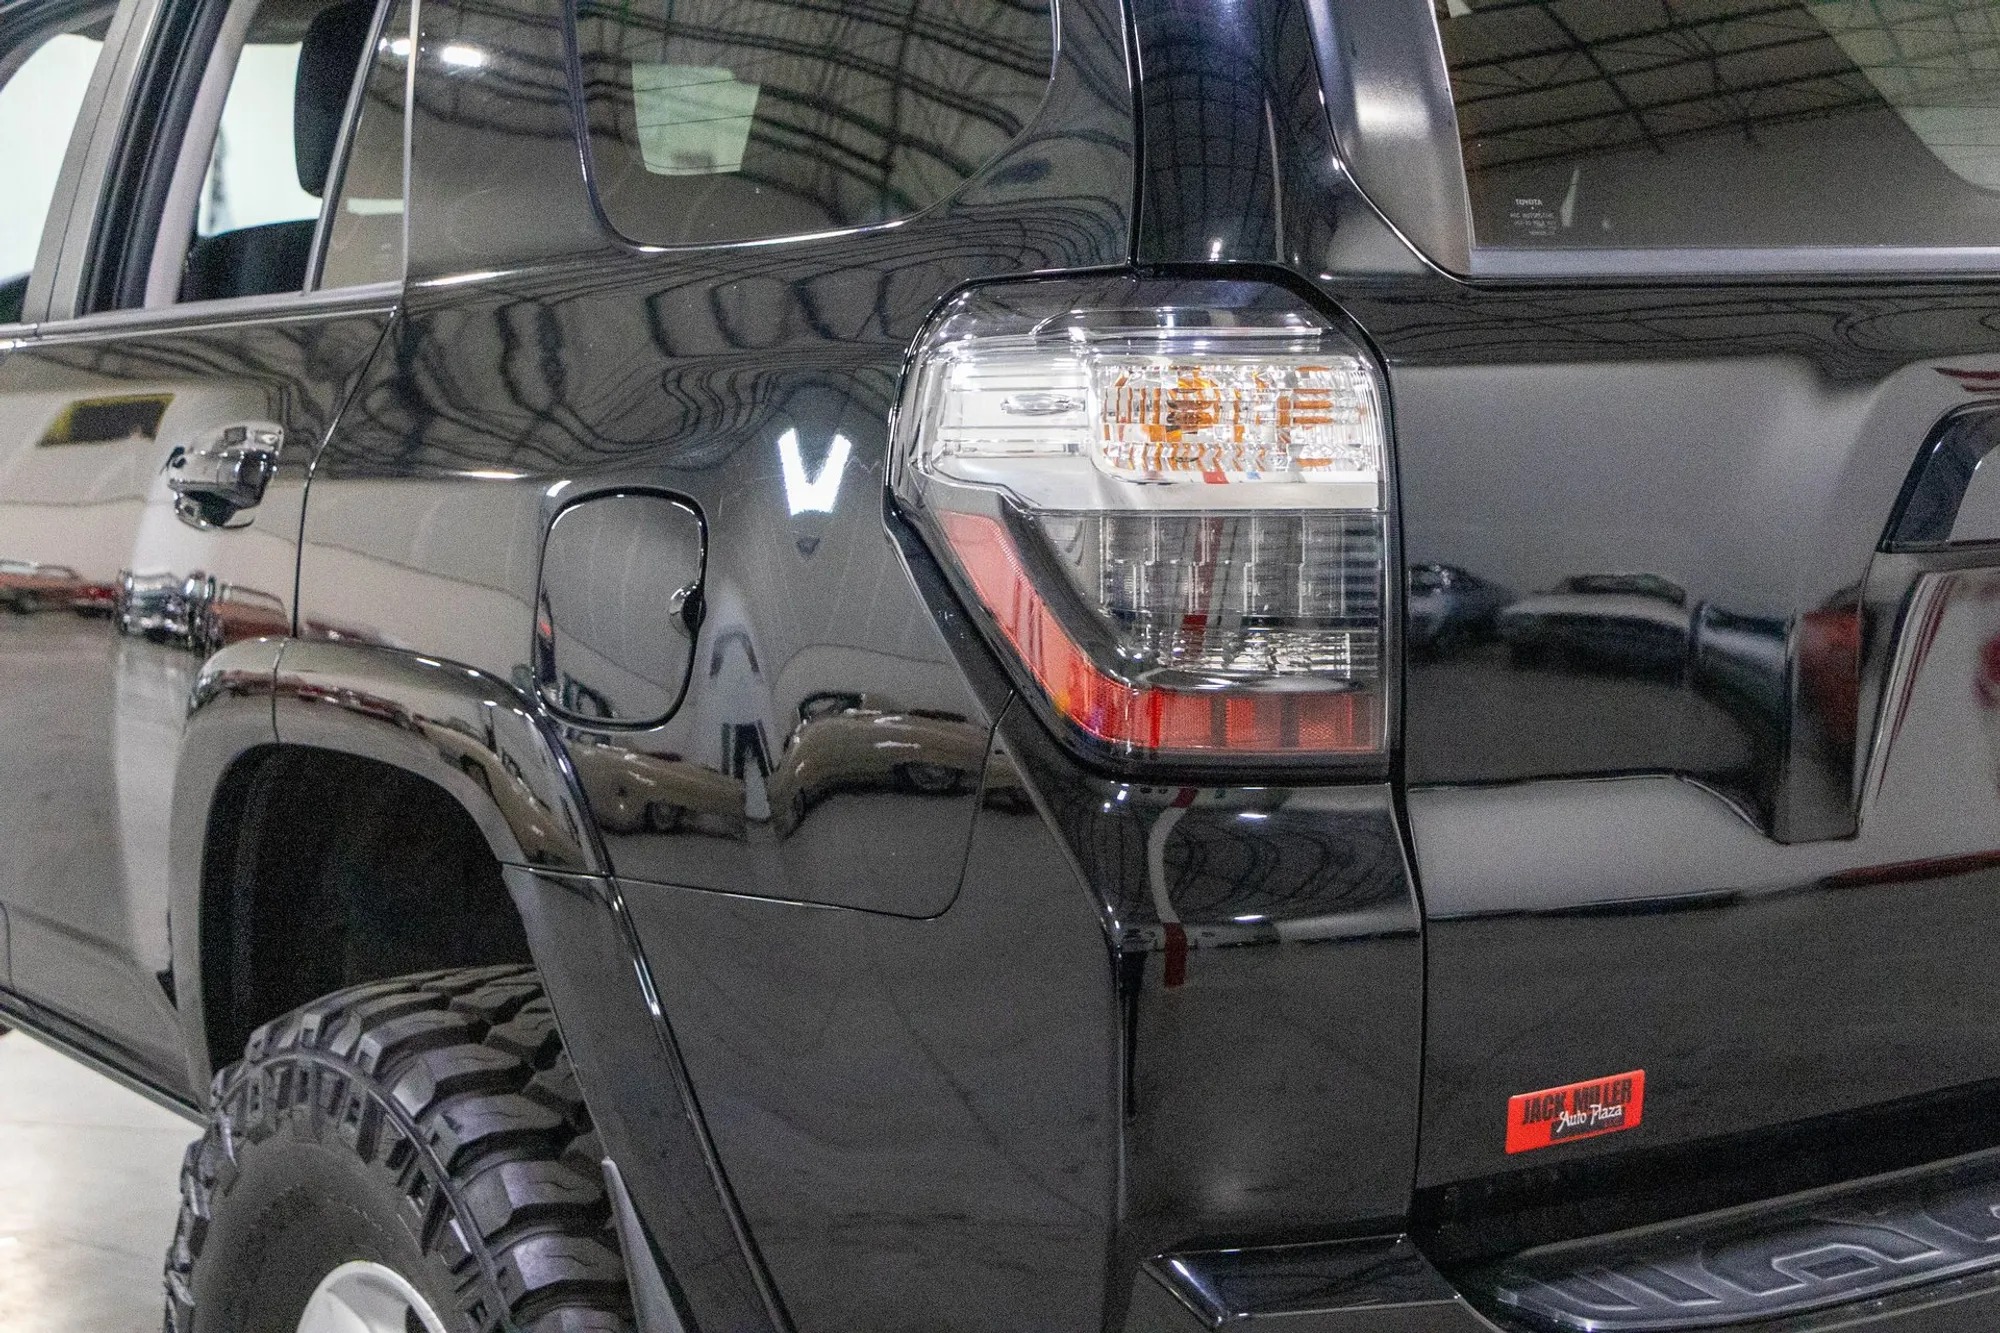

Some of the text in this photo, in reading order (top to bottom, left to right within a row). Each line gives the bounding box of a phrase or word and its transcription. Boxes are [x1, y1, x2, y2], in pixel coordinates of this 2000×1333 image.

[1515, 198, 1543, 206] TOYOTA
[1523, 1078, 1632, 1125] JACK MILLER
[1556, 1111, 1587, 1133] Auto
[1590, 1103, 1622, 1126] Plaza
